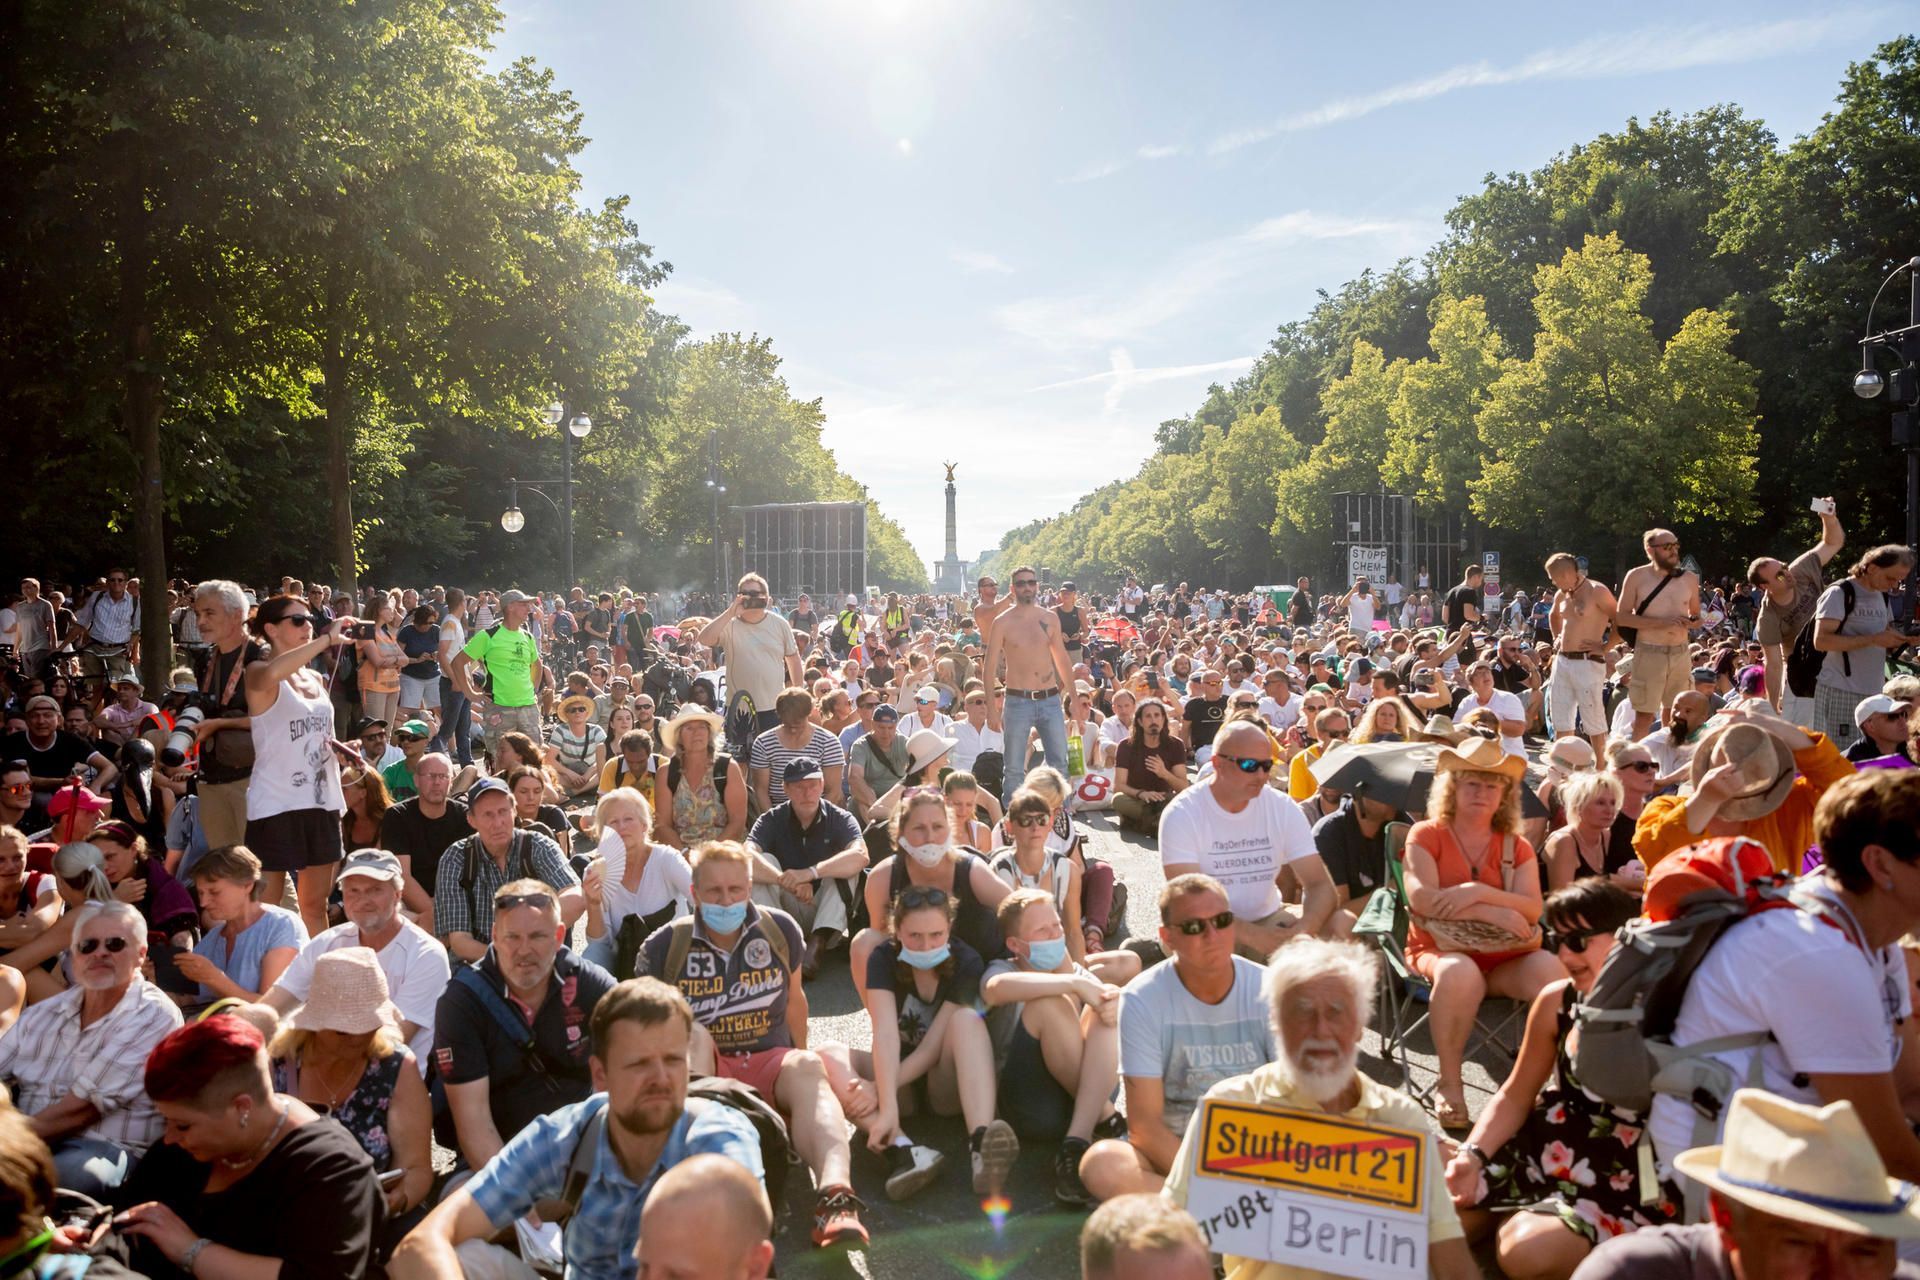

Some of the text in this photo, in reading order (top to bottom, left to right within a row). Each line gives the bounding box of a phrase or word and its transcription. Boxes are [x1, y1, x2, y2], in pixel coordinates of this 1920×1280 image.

[1352, 549, 1387, 560] STOPP
[1352, 561, 1388, 571] CHEM-
[1352, 573, 1386, 584] TAILS
[1213, 856, 1273, 869] QUERDENKEN
[686, 952, 717, 977] 63
[679, 976, 724, 996] FIELD
[728, 969, 784, 1003] David
[705, 1010, 772, 1034] OOTBALL
[1183, 1041, 1258, 1068] VISIONS
[1216, 1122, 1406, 1184] Stuttgart 21
[1284, 1205, 1417, 1269] Berlin
